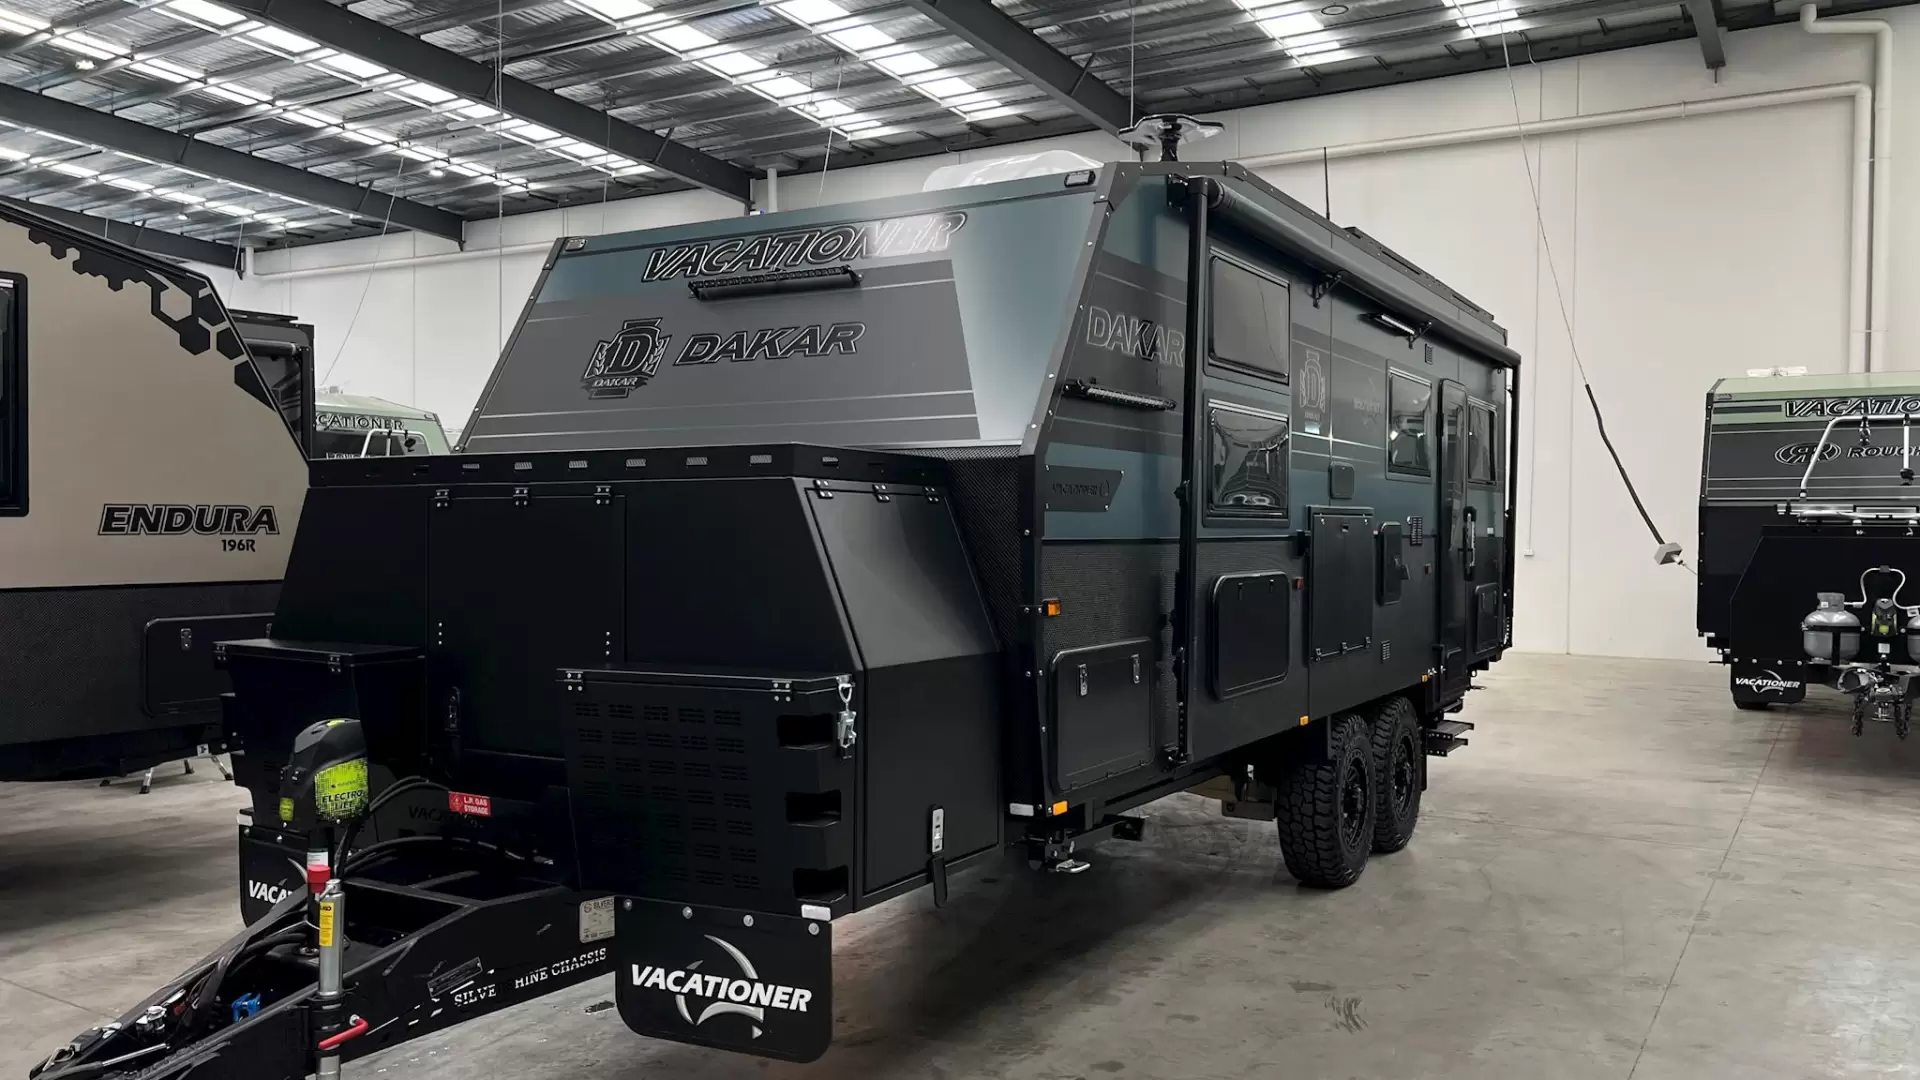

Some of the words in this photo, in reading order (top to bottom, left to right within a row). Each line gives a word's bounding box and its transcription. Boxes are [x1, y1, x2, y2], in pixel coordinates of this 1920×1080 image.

[641, 211, 968, 283] VACATIONER
[673, 321, 867, 367] DAKAR
[1086, 305, 1185, 369] DAKAR
[591, 377, 639, 388] DAKAR
[315, 412, 405, 431] CATIONER
[98, 503, 281, 536] ENDURA
[221, 539, 256, 552] 196R
[1735, 677, 1801, 689] VACATIONER
[322, 789, 363, 803] ELECTRO
[474, 797, 488, 807] GAS
[463, 804, 489, 815] STORAGE
[248, 879, 293, 905] VACA
[551, 947, 607, 977] CHASSIS
[631, 963, 813, 1013] VACATIONER
